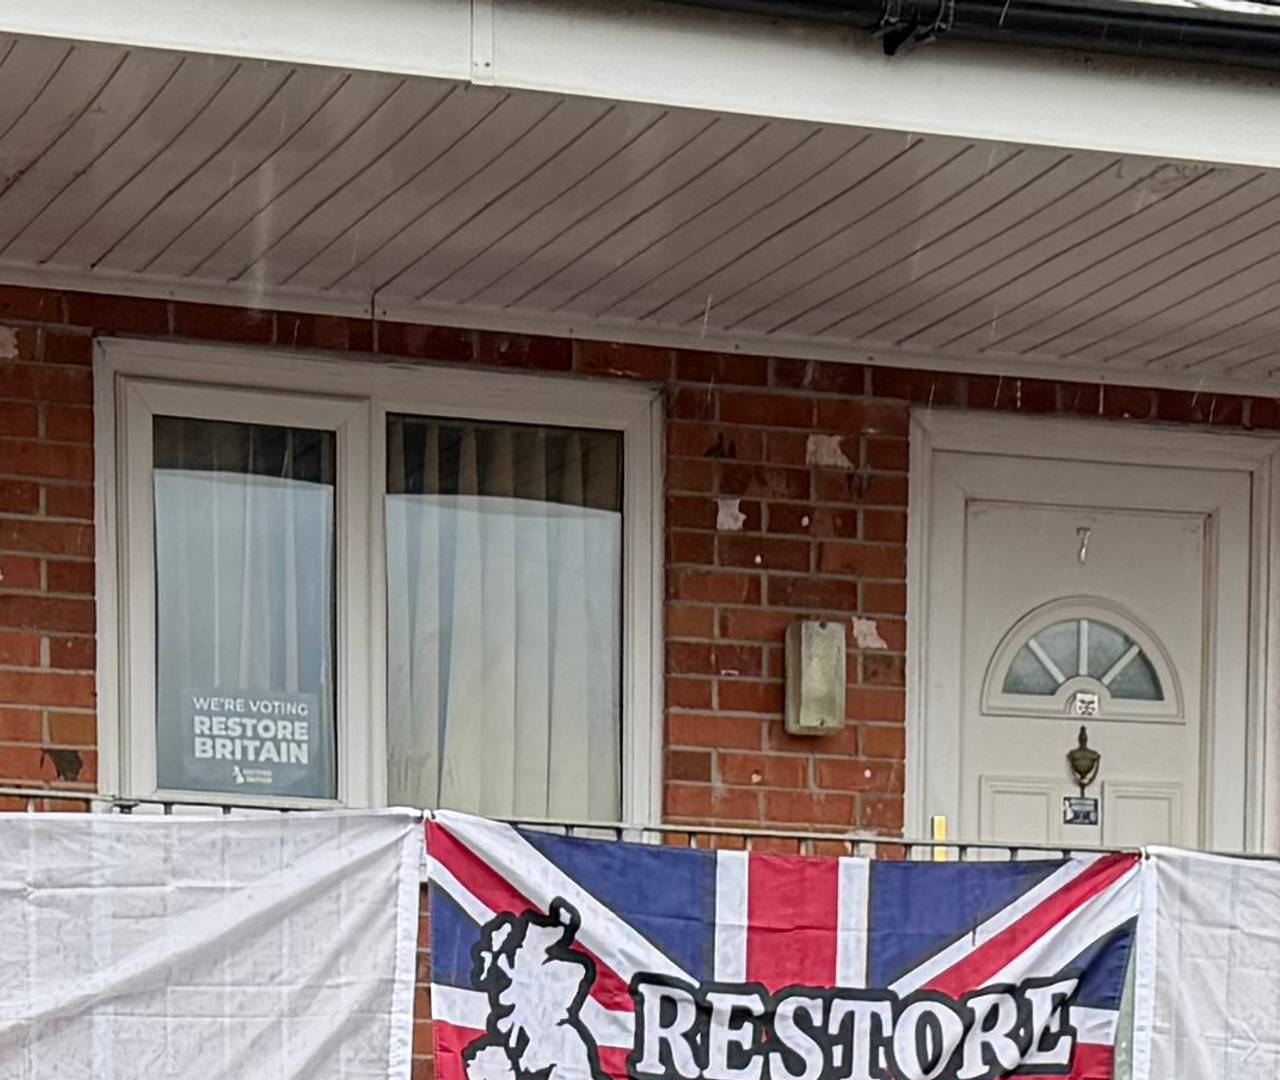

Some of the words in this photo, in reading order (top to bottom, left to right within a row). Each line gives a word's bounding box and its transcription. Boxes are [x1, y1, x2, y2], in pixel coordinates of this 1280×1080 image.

[1076, 526, 1091, 565] 7
[193, 697, 246, 713] WE'RE
[249, 699, 309, 716] VOTING
[194, 715, 309, 741] RESTORE
[194, 736, 309, 765] BRITAIN
